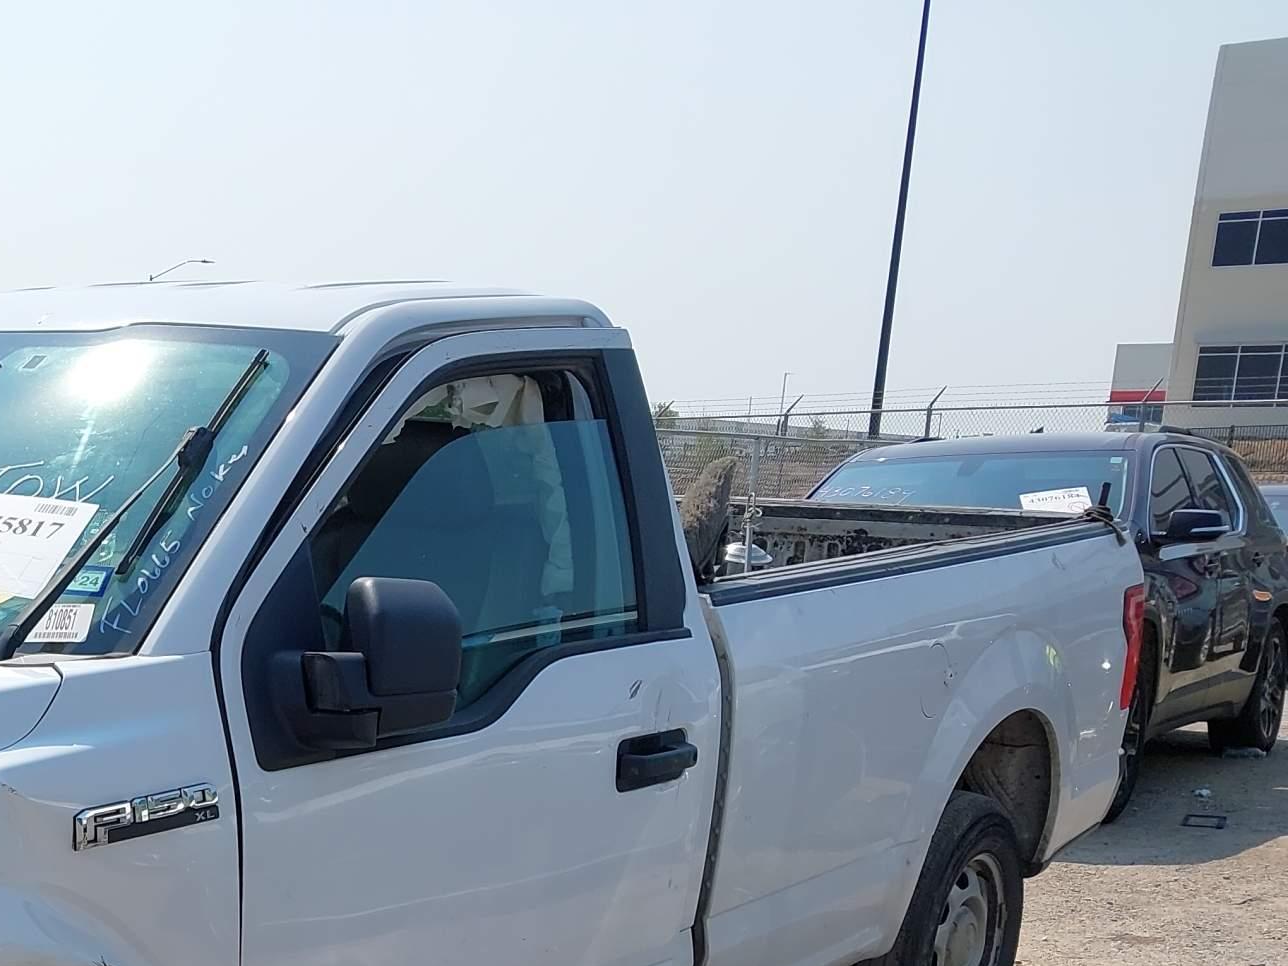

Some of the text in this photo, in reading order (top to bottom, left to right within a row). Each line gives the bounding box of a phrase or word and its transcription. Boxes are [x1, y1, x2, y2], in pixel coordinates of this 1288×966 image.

[79, 575, 100, 587] 24
[45, 609, 77, 631] 810851
[195, 810, 216, 822] XL
